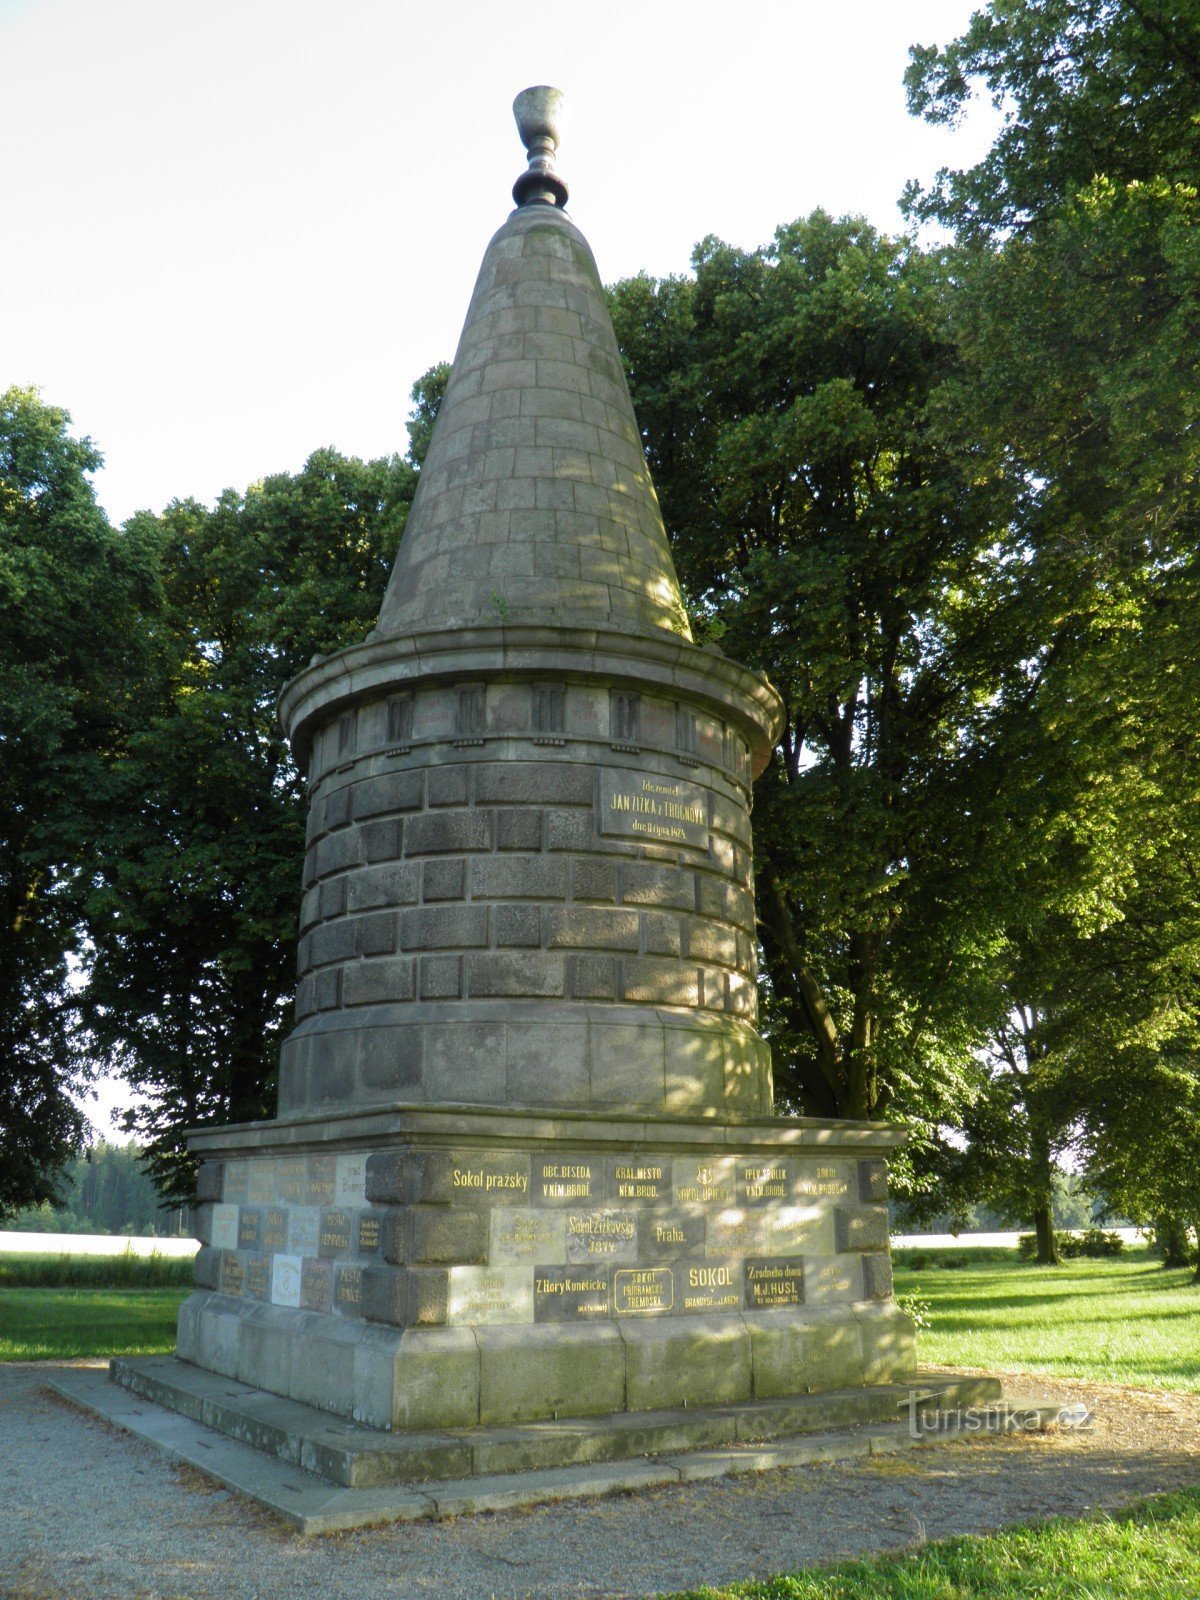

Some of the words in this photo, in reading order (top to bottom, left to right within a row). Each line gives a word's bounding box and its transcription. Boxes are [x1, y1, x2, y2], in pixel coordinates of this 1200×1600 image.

[642, 779, 655, 792] Zde
[610, 793, 630, 811] JAN
[632, 792, 656, 815] ŽIŽKA
[657, 804, 662, 815] z
[632, 819, 647, 832] dne
[453, 1169, 483, 1187] Sokol
[486, 1171, 528, 1193] pražský
[676, 1186, 700, 1201] SOKOL
[569, 1216, 591, 1234] Sokol
[656, 1227, 687, 1243] Praha.
[632, 1272, 655, 1284] SOKOL
[689, 1267, 733, 1287] SOKOL
[536, 1280, 542, 1293] Z
[543, 1280, 564, 1296] Hory
